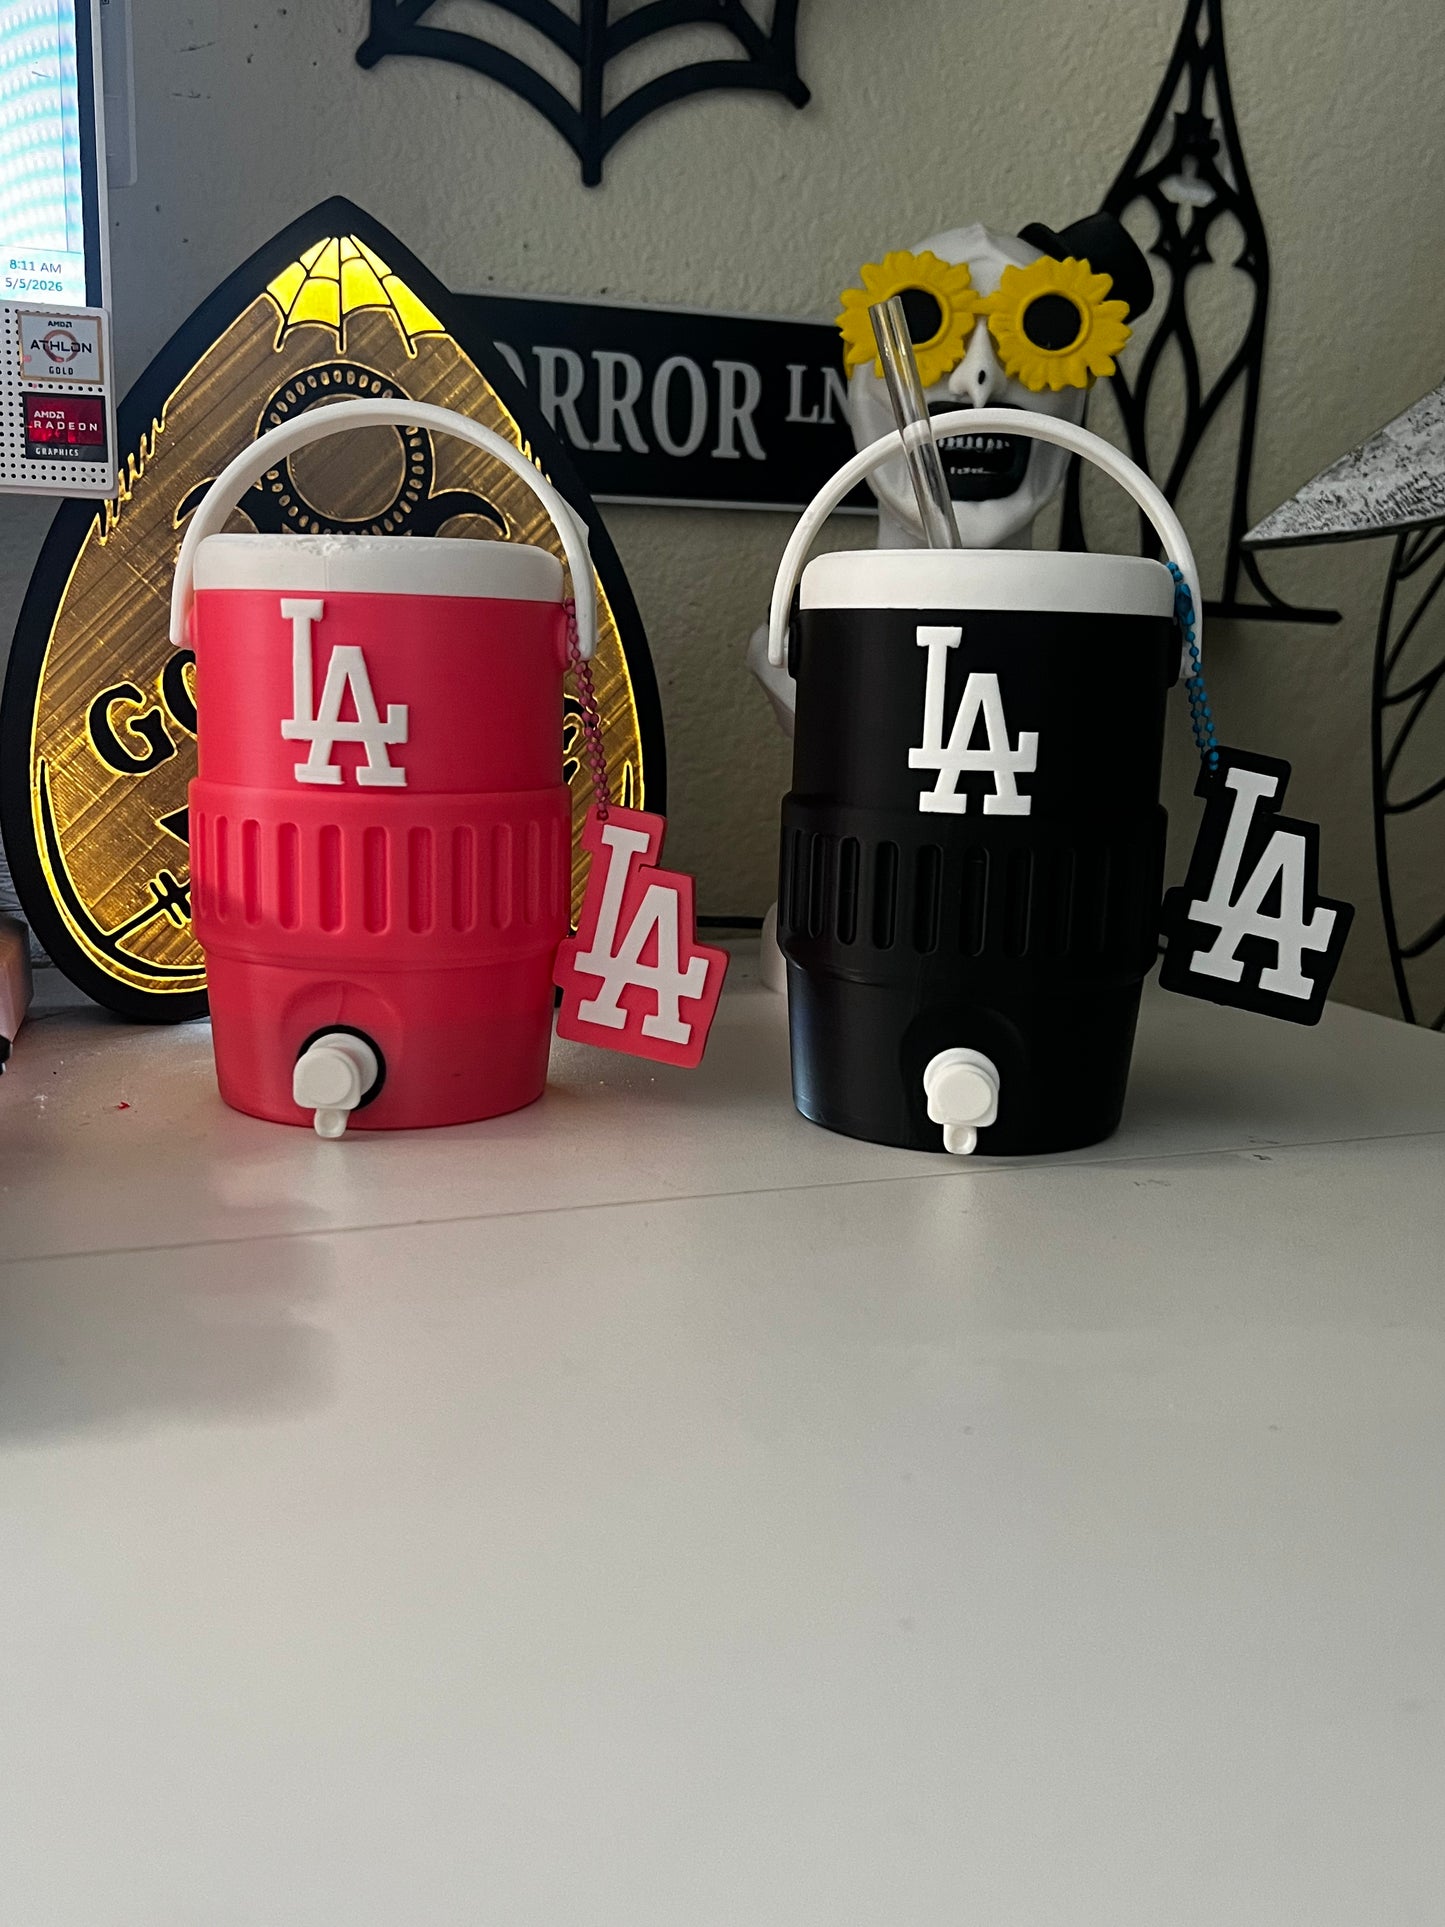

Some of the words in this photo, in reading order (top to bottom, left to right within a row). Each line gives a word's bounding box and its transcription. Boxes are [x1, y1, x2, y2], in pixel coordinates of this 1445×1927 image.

[9, 259, 36, 271] 8:11
[40, 262, 62, 274] AM
[5, 277, 63, 292] 5/5/2026
[47, 320, 73, 328] AMD
[30, 339, 92, 353] ATHLON
[48, 366, 74, 375] GOLD
[493, 341, 768, 461] RROR
[33, 410, 65, 420] AMD
[33, 420, 98, 432] RADEON
[35, 447, 80, 457] GRAPHICS
[280, 598, 408, 787] LA
[908, 626, 1039, 815] LA
[1188, 767, 1337, 1000] LA
[573, 824, 710, 1045] LA
